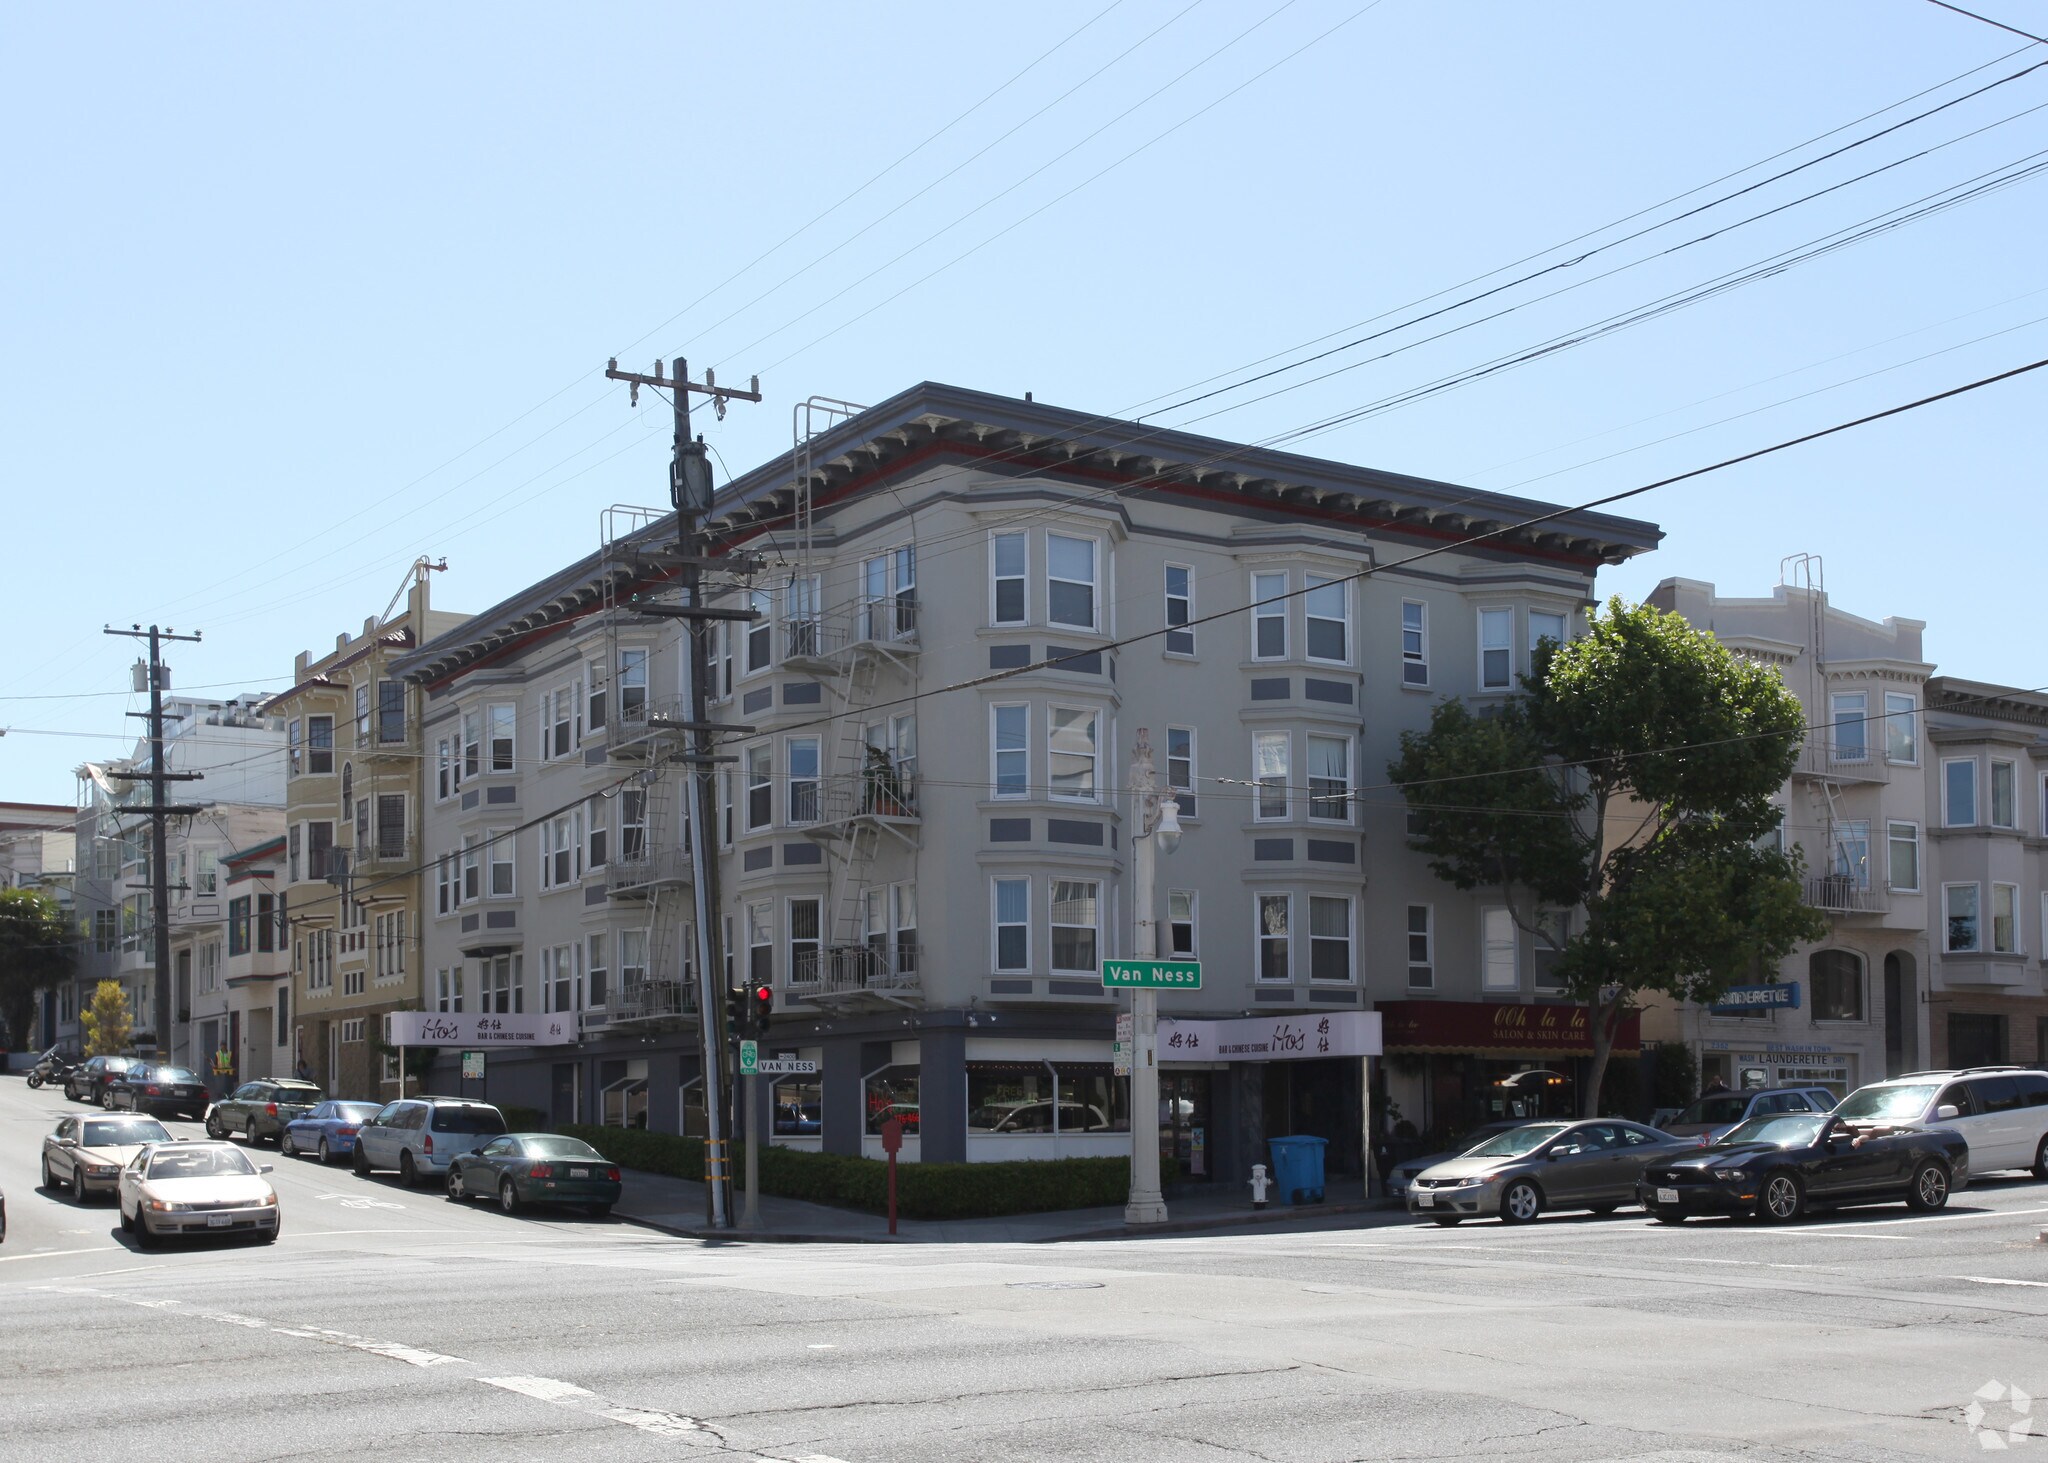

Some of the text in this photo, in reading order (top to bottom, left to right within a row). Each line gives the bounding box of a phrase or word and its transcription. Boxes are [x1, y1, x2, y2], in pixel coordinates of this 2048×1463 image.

[1110, 966, 1194, 982] Van Ness
[1541, 1007, 1556, 1027] la
[1570, 1008, 1585, 1028] la
[515, 1033, 535, 1041] CUISINE
[1493, 1030, 1586, 1041] SALON & SKIN CARE
[1232, 1043, 1250, 1053] CHINESE
[1251, 1042, 1269, 1052] CUISINE
[1766, 1043, 1783, 1052] BEST
[1785, 1044, 1804, 1052] WASH
[1813, 1045, 1831, 1053] TOWN
[1759, 1054, 1828, 1065] LAUNDERETTE
[761, 1062, 814, 1071] VAN NESS
